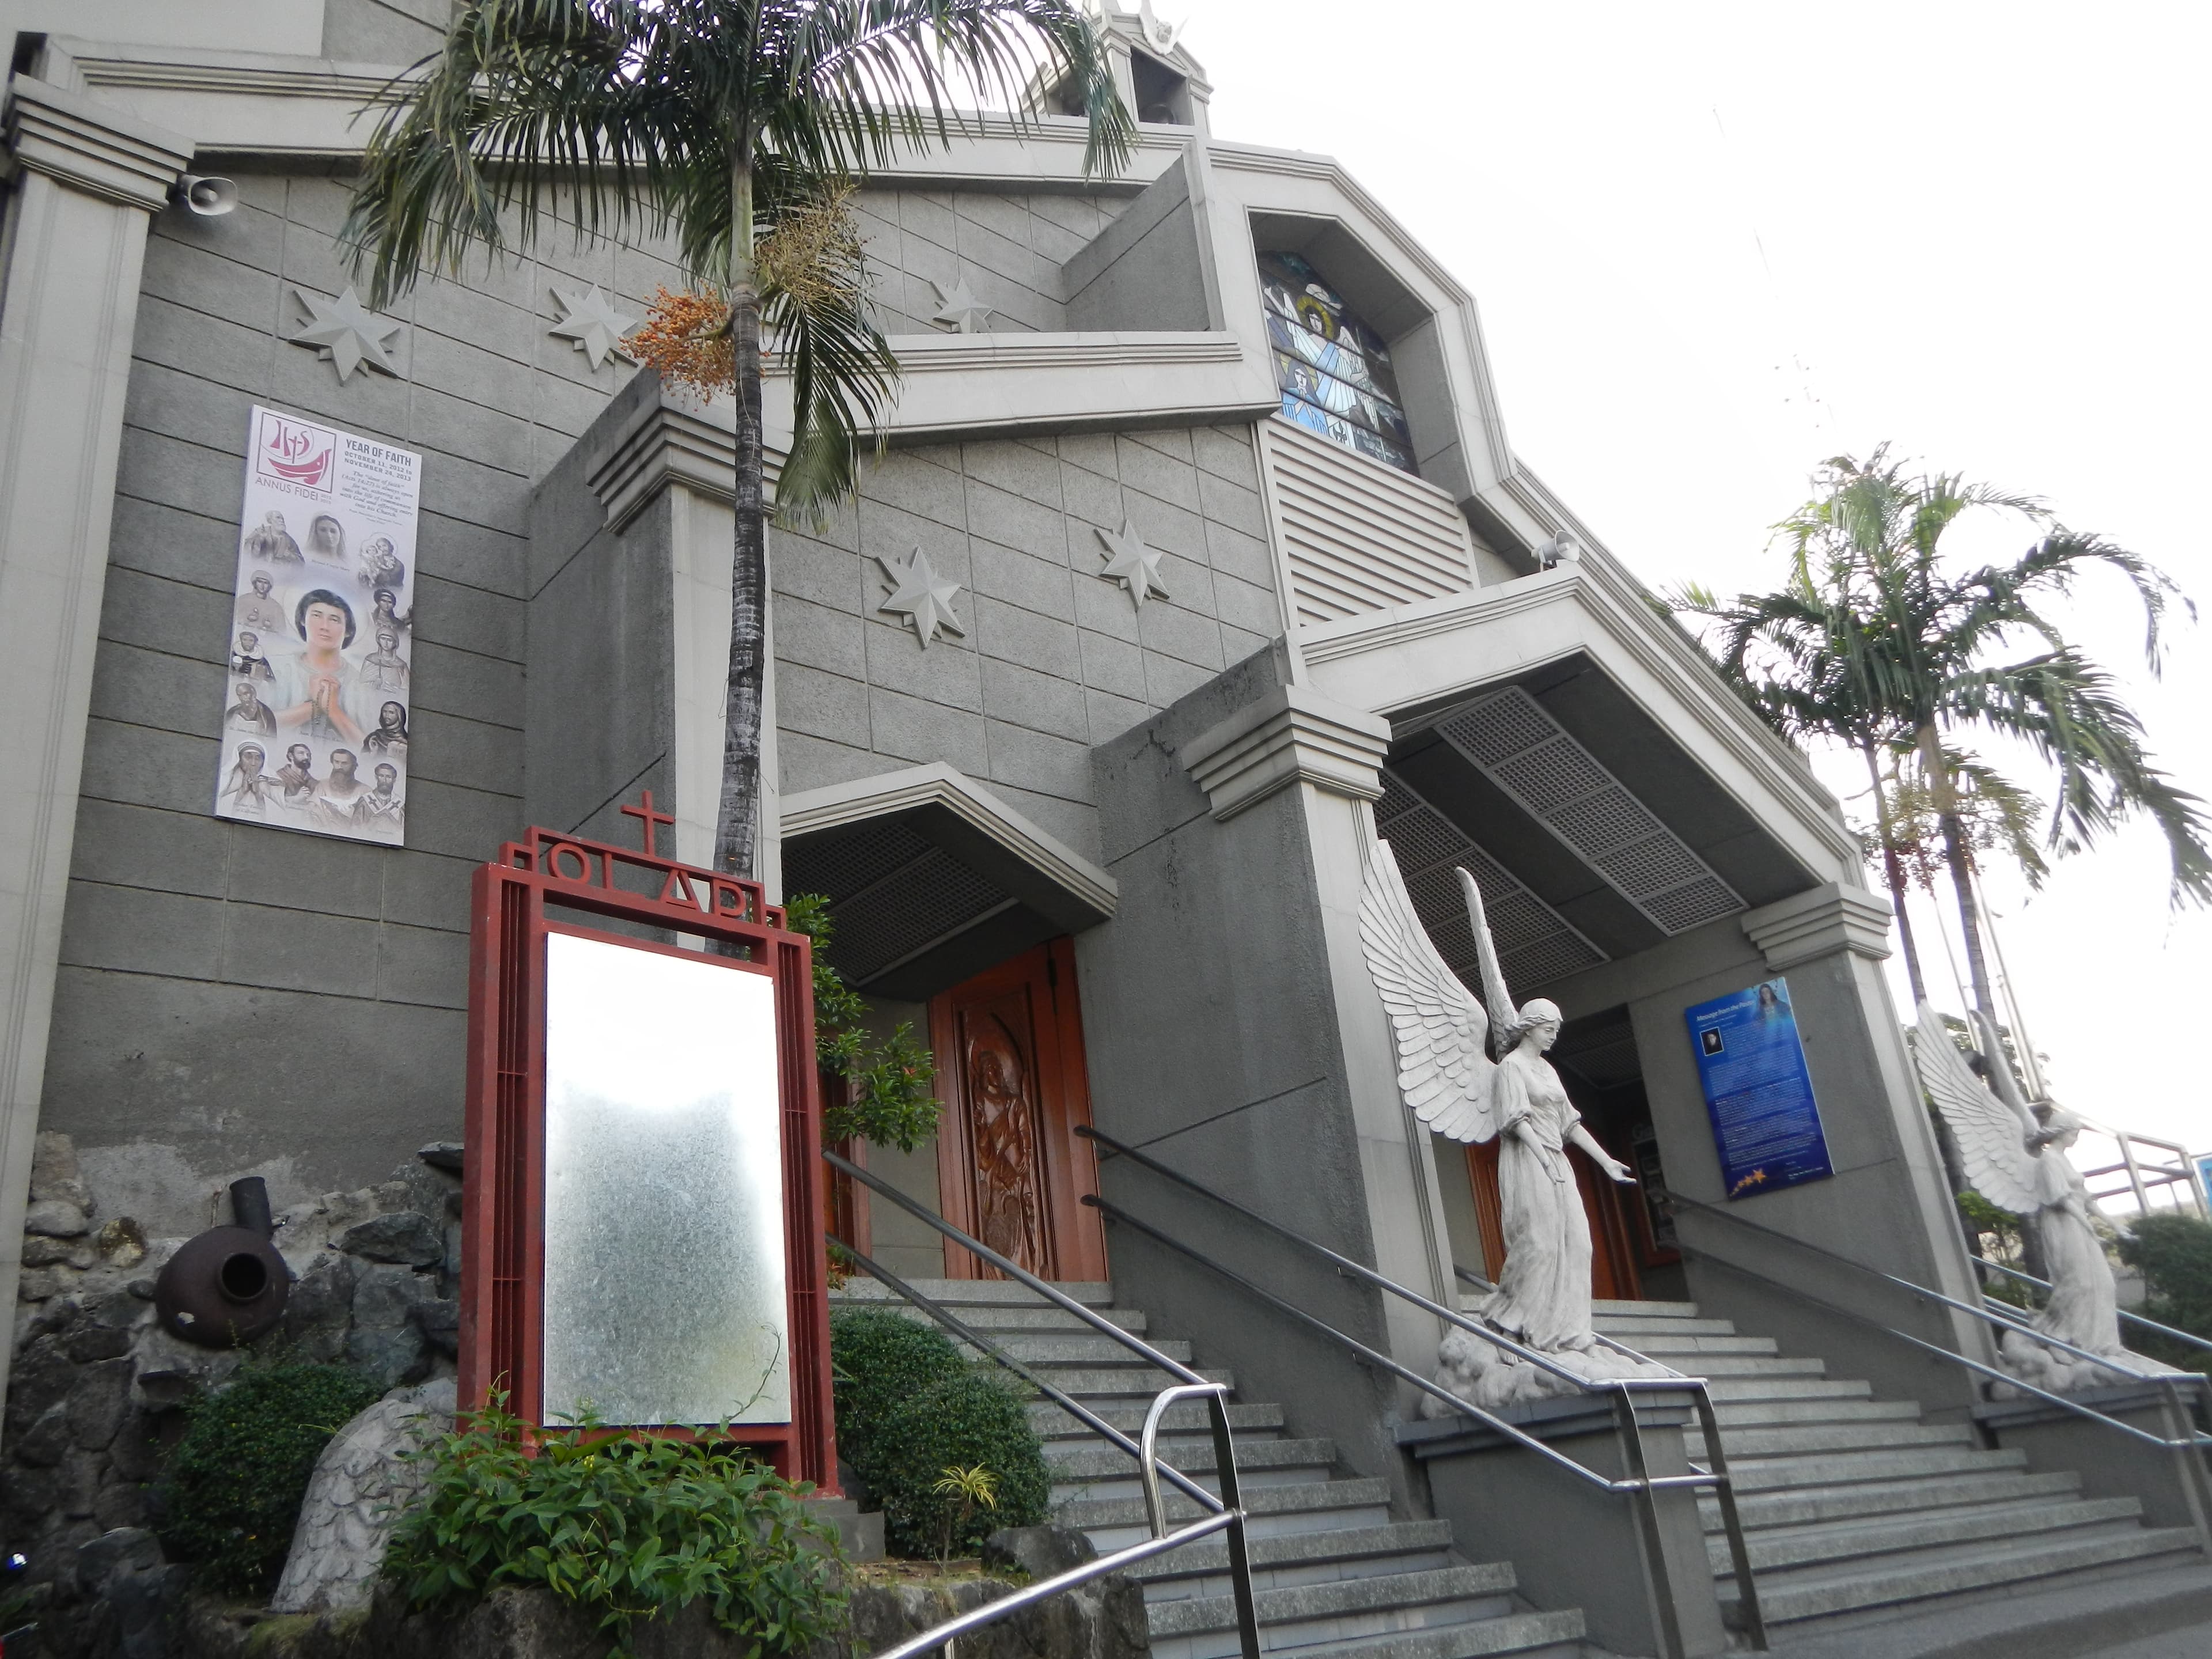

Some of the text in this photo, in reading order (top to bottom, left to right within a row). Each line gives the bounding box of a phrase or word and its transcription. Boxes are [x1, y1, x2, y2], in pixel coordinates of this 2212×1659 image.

[344, 450, 376, 464] OCTOBER
[389, 464, 404, 472] 2012
[346, 438, 411, 467] YEAR OF FAITH
[344, 457, 383, 473] NOVEMBER
[396, 473, 411, 482] 2013
[255, 476, 318, 501] ANNUS FIDEI
